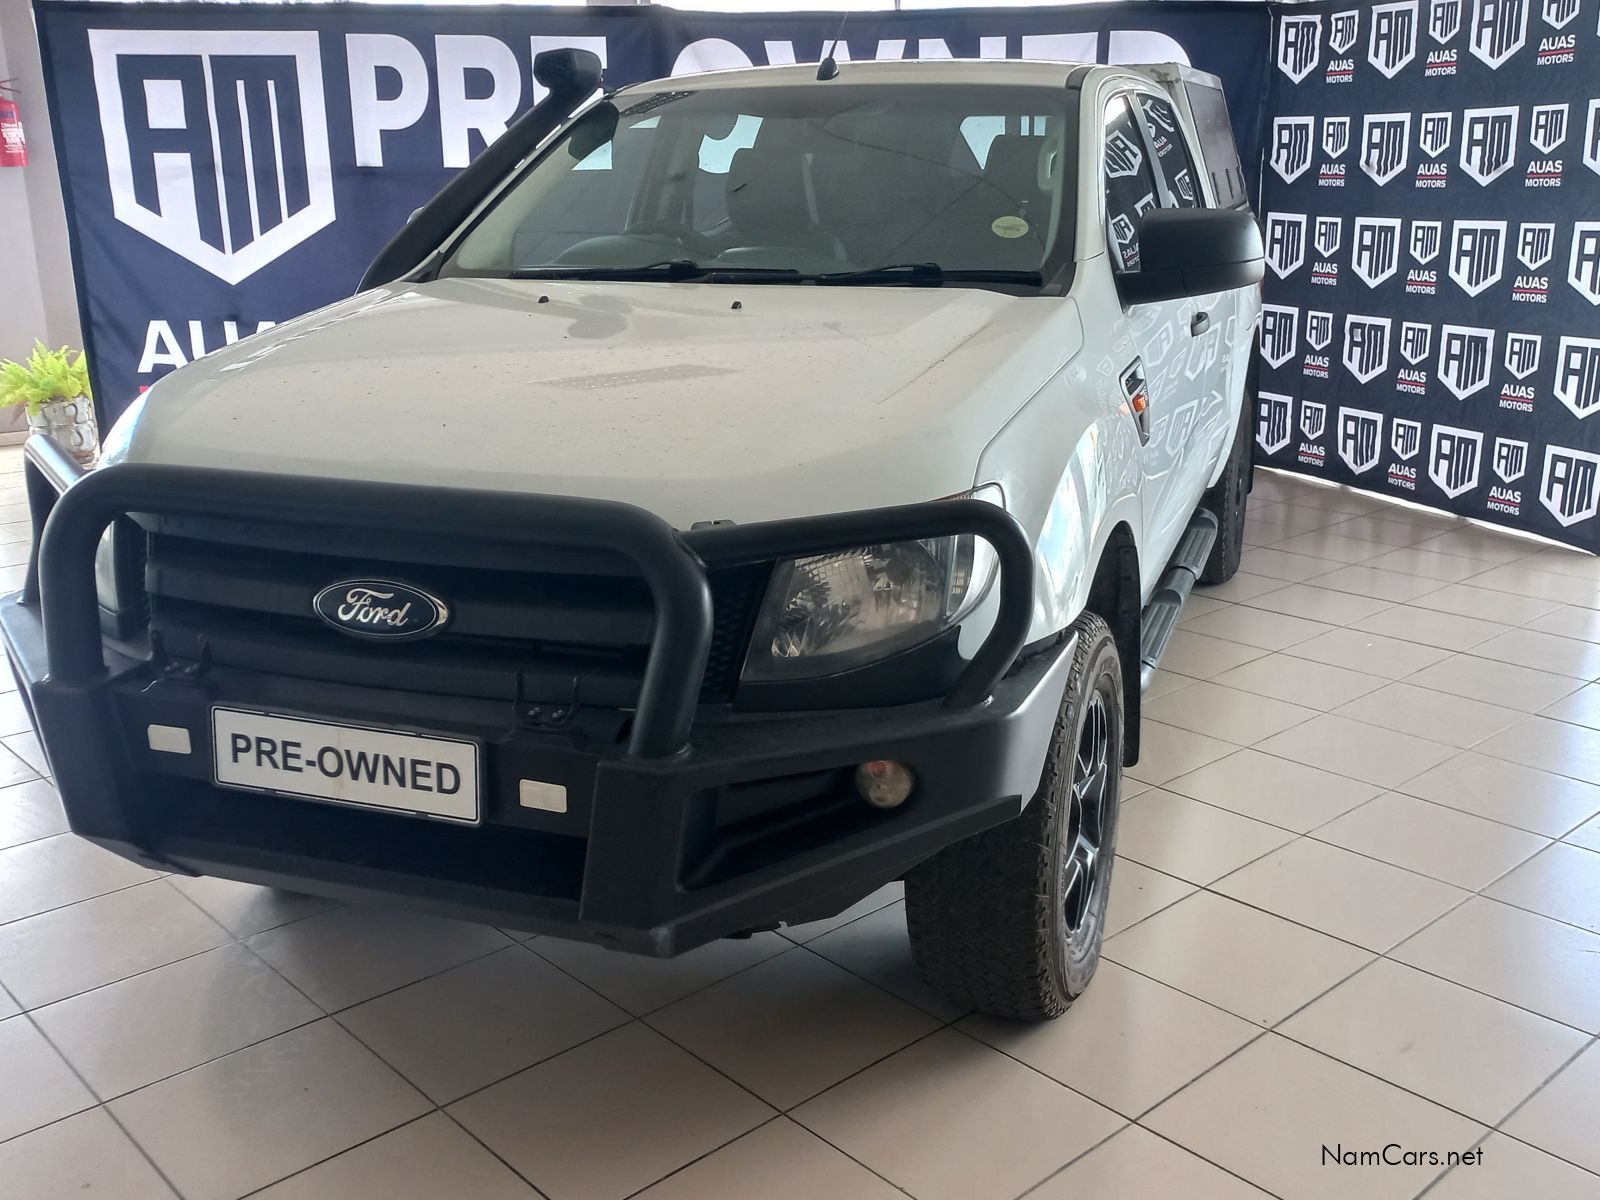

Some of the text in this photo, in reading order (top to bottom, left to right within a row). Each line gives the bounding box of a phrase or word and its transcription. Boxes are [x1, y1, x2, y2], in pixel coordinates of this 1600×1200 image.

[1538, 34, 1576, 52] AUAS
[1426, 48, 1458, 64] AUAS
[1536, 52, 1574, 66] MOTORS
[1326, 58, 1355, 72] AUAS
[1424, 65, 1457, 77] MOTORS
[1325, 74, 1353, 84] MOTORS
[1319, 163, 1346, 175] AUAS
[1416, 163, 1448, 176] AUAS
[1526, 159, 1563, 174] AUAS
[1318, 178, 1345, 187] MOTORS
[1415, 179, 1447, 189] MOTORS
[1524, 177, 1562, 188] MOTORS
[1312, 261, 1338, 275] AUAS
[1310, 276, 1337, 286] MOTORS
[1406, 269, 1437, 283] AUAS
[1513, 275, 1549, 290] AUAS
[1405, 284, 1436, 295] MOTORS
[1511, 292, 1548, 304] MOTORS
[1303, 354, 1330, 368] AUAS
[1302, 367, 1329, 379] MOTORS
[1397, 368, 1427, 383] AUAS
[1395, 382, 1426, 395] MOTORS
[1500, 383, 1536, 400] AUAS
[1498, 399, 1534, 413] MOTORS
[1298, 442, 1326, 457] AUAS
[1297, 454, 1325, 467] MOTORS
[1387, 462, 1417, 479] AUAS
[1387, 476, 1416, 491] MOTORS
[1488, 485, 1522, 504] AUAS
[1486, 500, 1520, 516] MOTORS
[337, 588, 411, 628] Ford
[230, 732, 462, 796] PRE-OWNED
